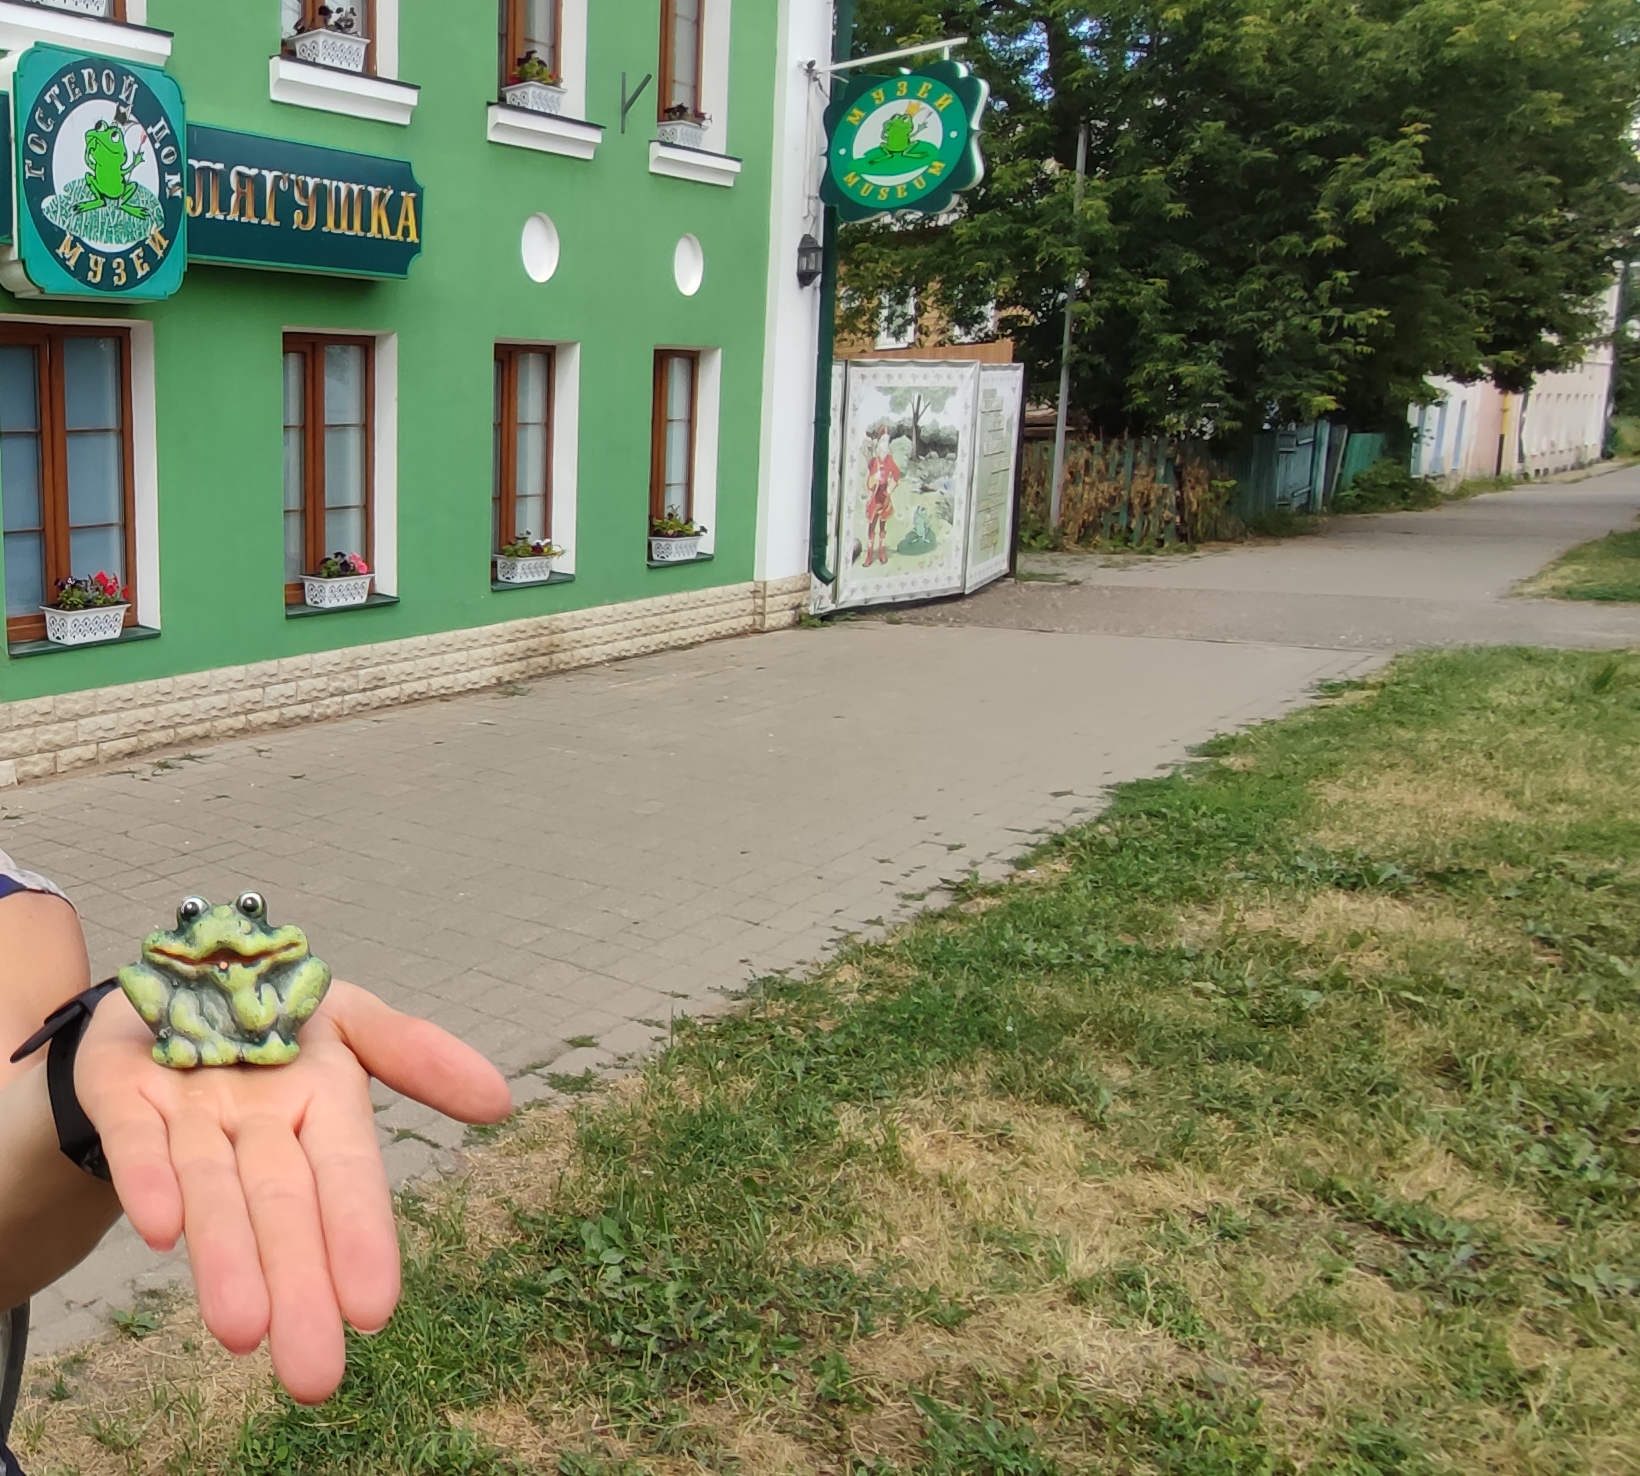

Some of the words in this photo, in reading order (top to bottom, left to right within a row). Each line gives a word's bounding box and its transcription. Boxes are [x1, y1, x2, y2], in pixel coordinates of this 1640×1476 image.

[25, 68, 139, 181] ГОСТЕВОЙ
[147, 115, 184, 200] ДОМ
[847, 81, 954, 126] МУЗЕЙ
[186, 158, 420, 244] ЛЯГУШКА
[843, 161, 946, 200] MUSEUM
